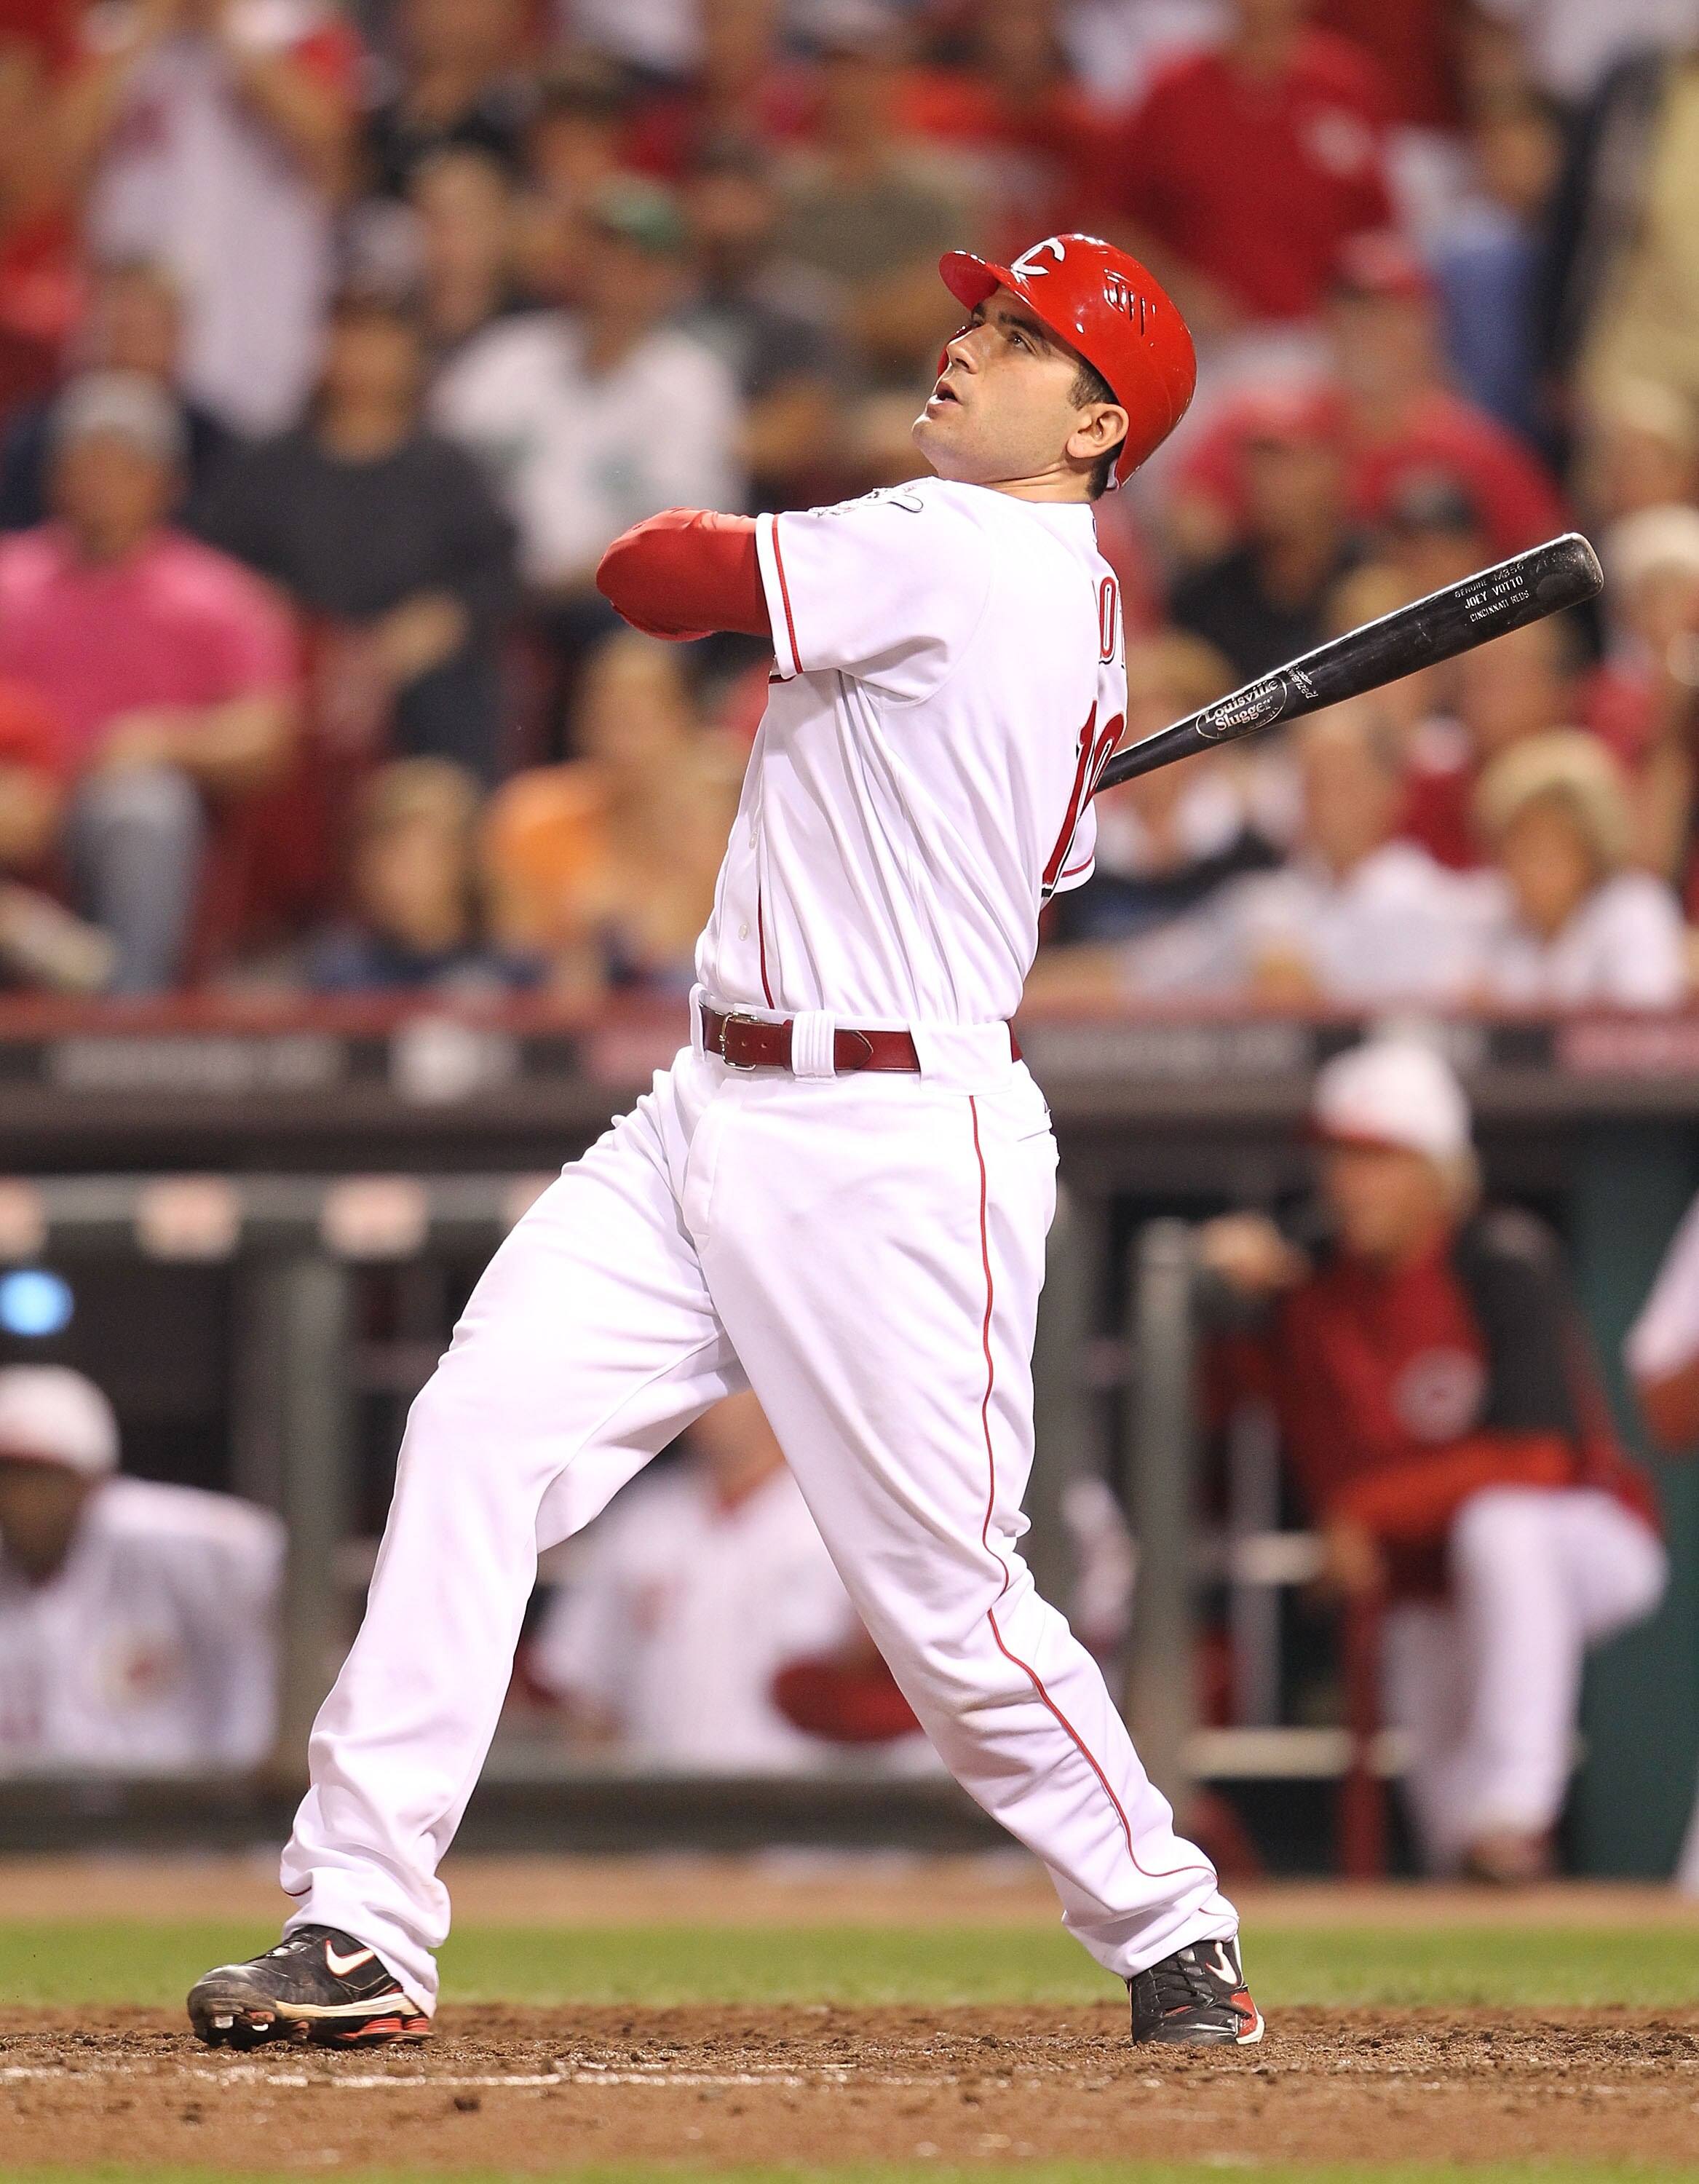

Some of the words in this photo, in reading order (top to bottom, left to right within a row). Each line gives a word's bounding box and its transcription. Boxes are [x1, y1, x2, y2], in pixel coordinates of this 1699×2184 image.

[1454, 579, 1487, 598] GENUINE
[1465, 591, 1487, 609] JOEY
[1492, 575, 1524, 596] VOTTO
[1470, 599, 1509, 622] CINCINNATI
[1510, 590, 1530, 604] REDS
[1203, 679, 1279, 723] Louisville
[1215, 698, 1272, 731] Slugger
